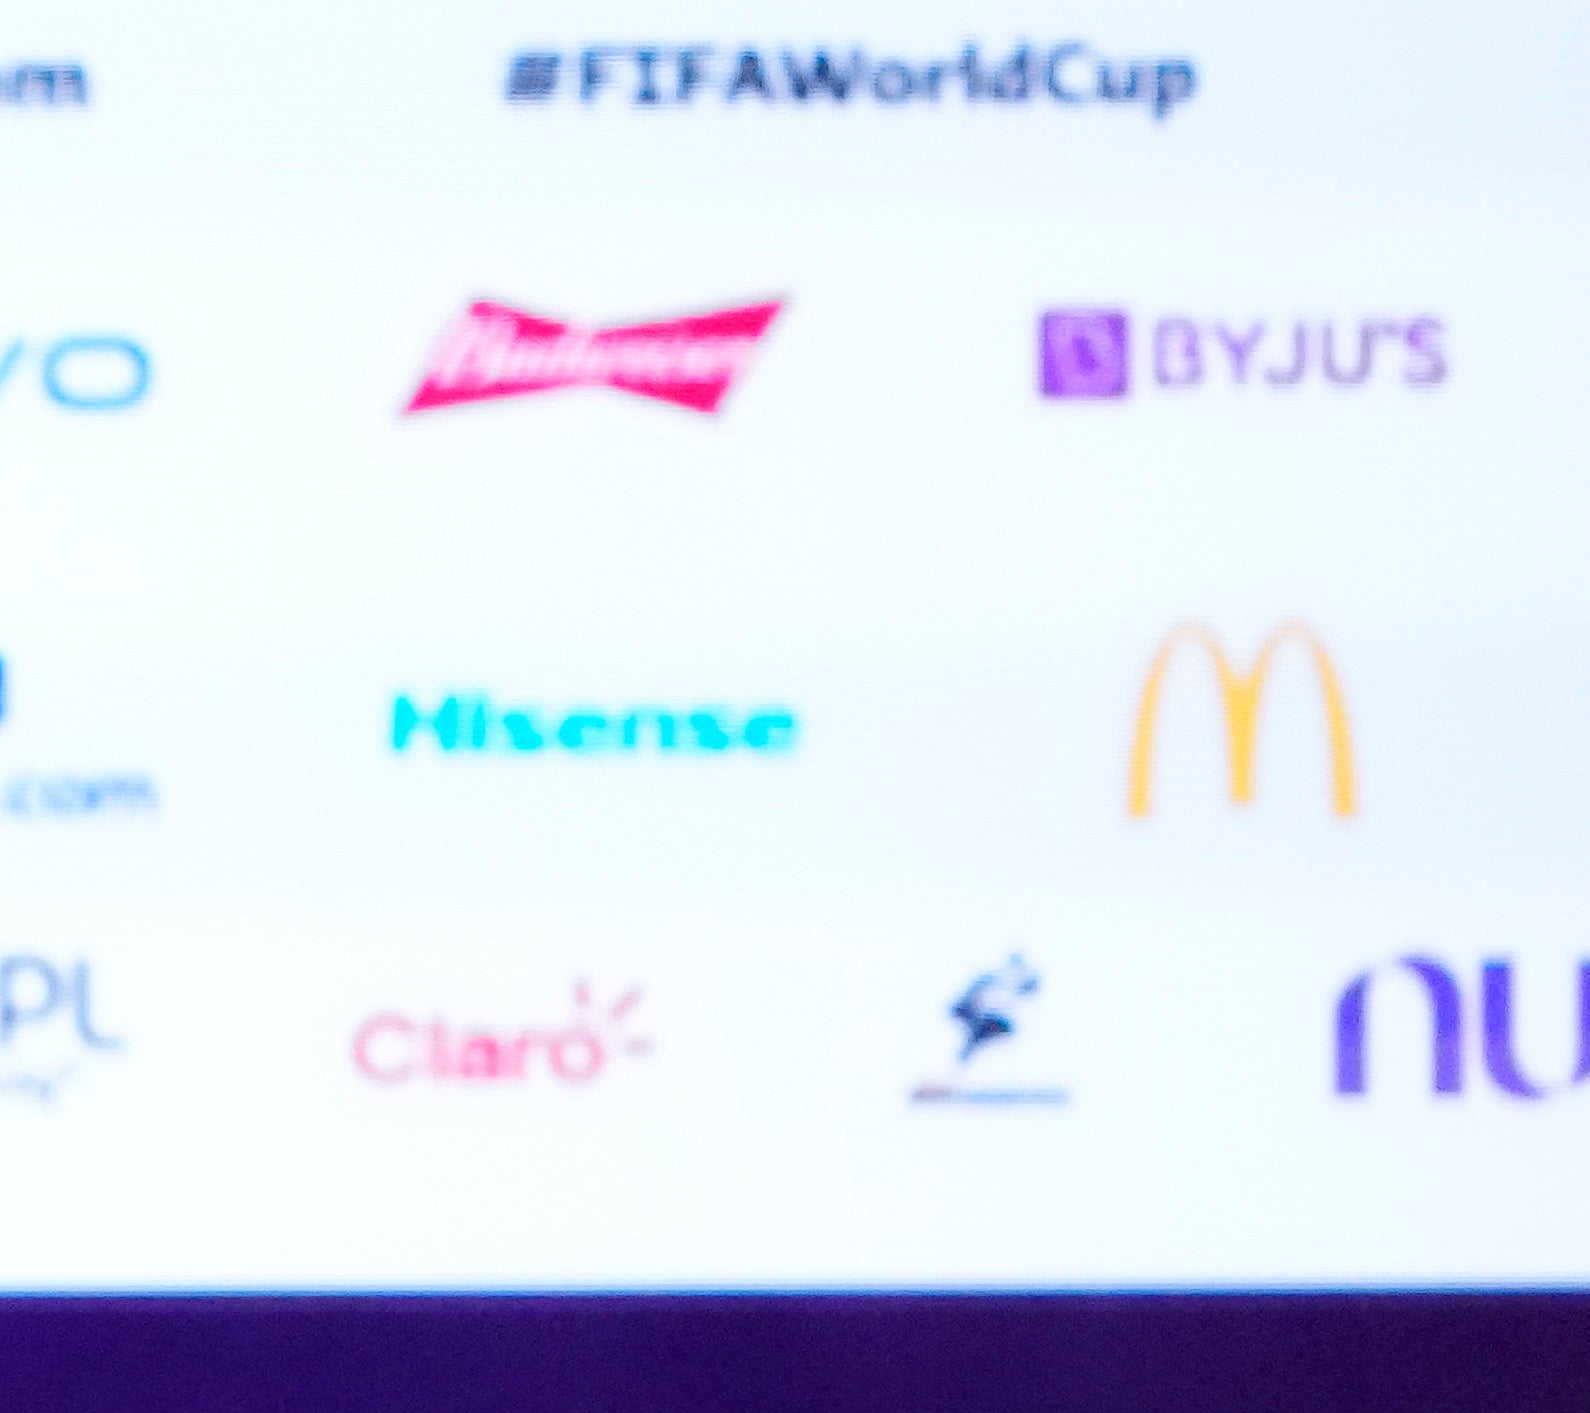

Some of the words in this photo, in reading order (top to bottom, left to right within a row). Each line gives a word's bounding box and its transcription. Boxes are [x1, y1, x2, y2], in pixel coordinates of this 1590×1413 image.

[505, 43, 1198, 120] #FIFAWorldCup
[1152, 314, 1449, 389] BYJU'S
[389, 693, 799, 754] Hisense
[351, 1010, 606, 1085] Claro
